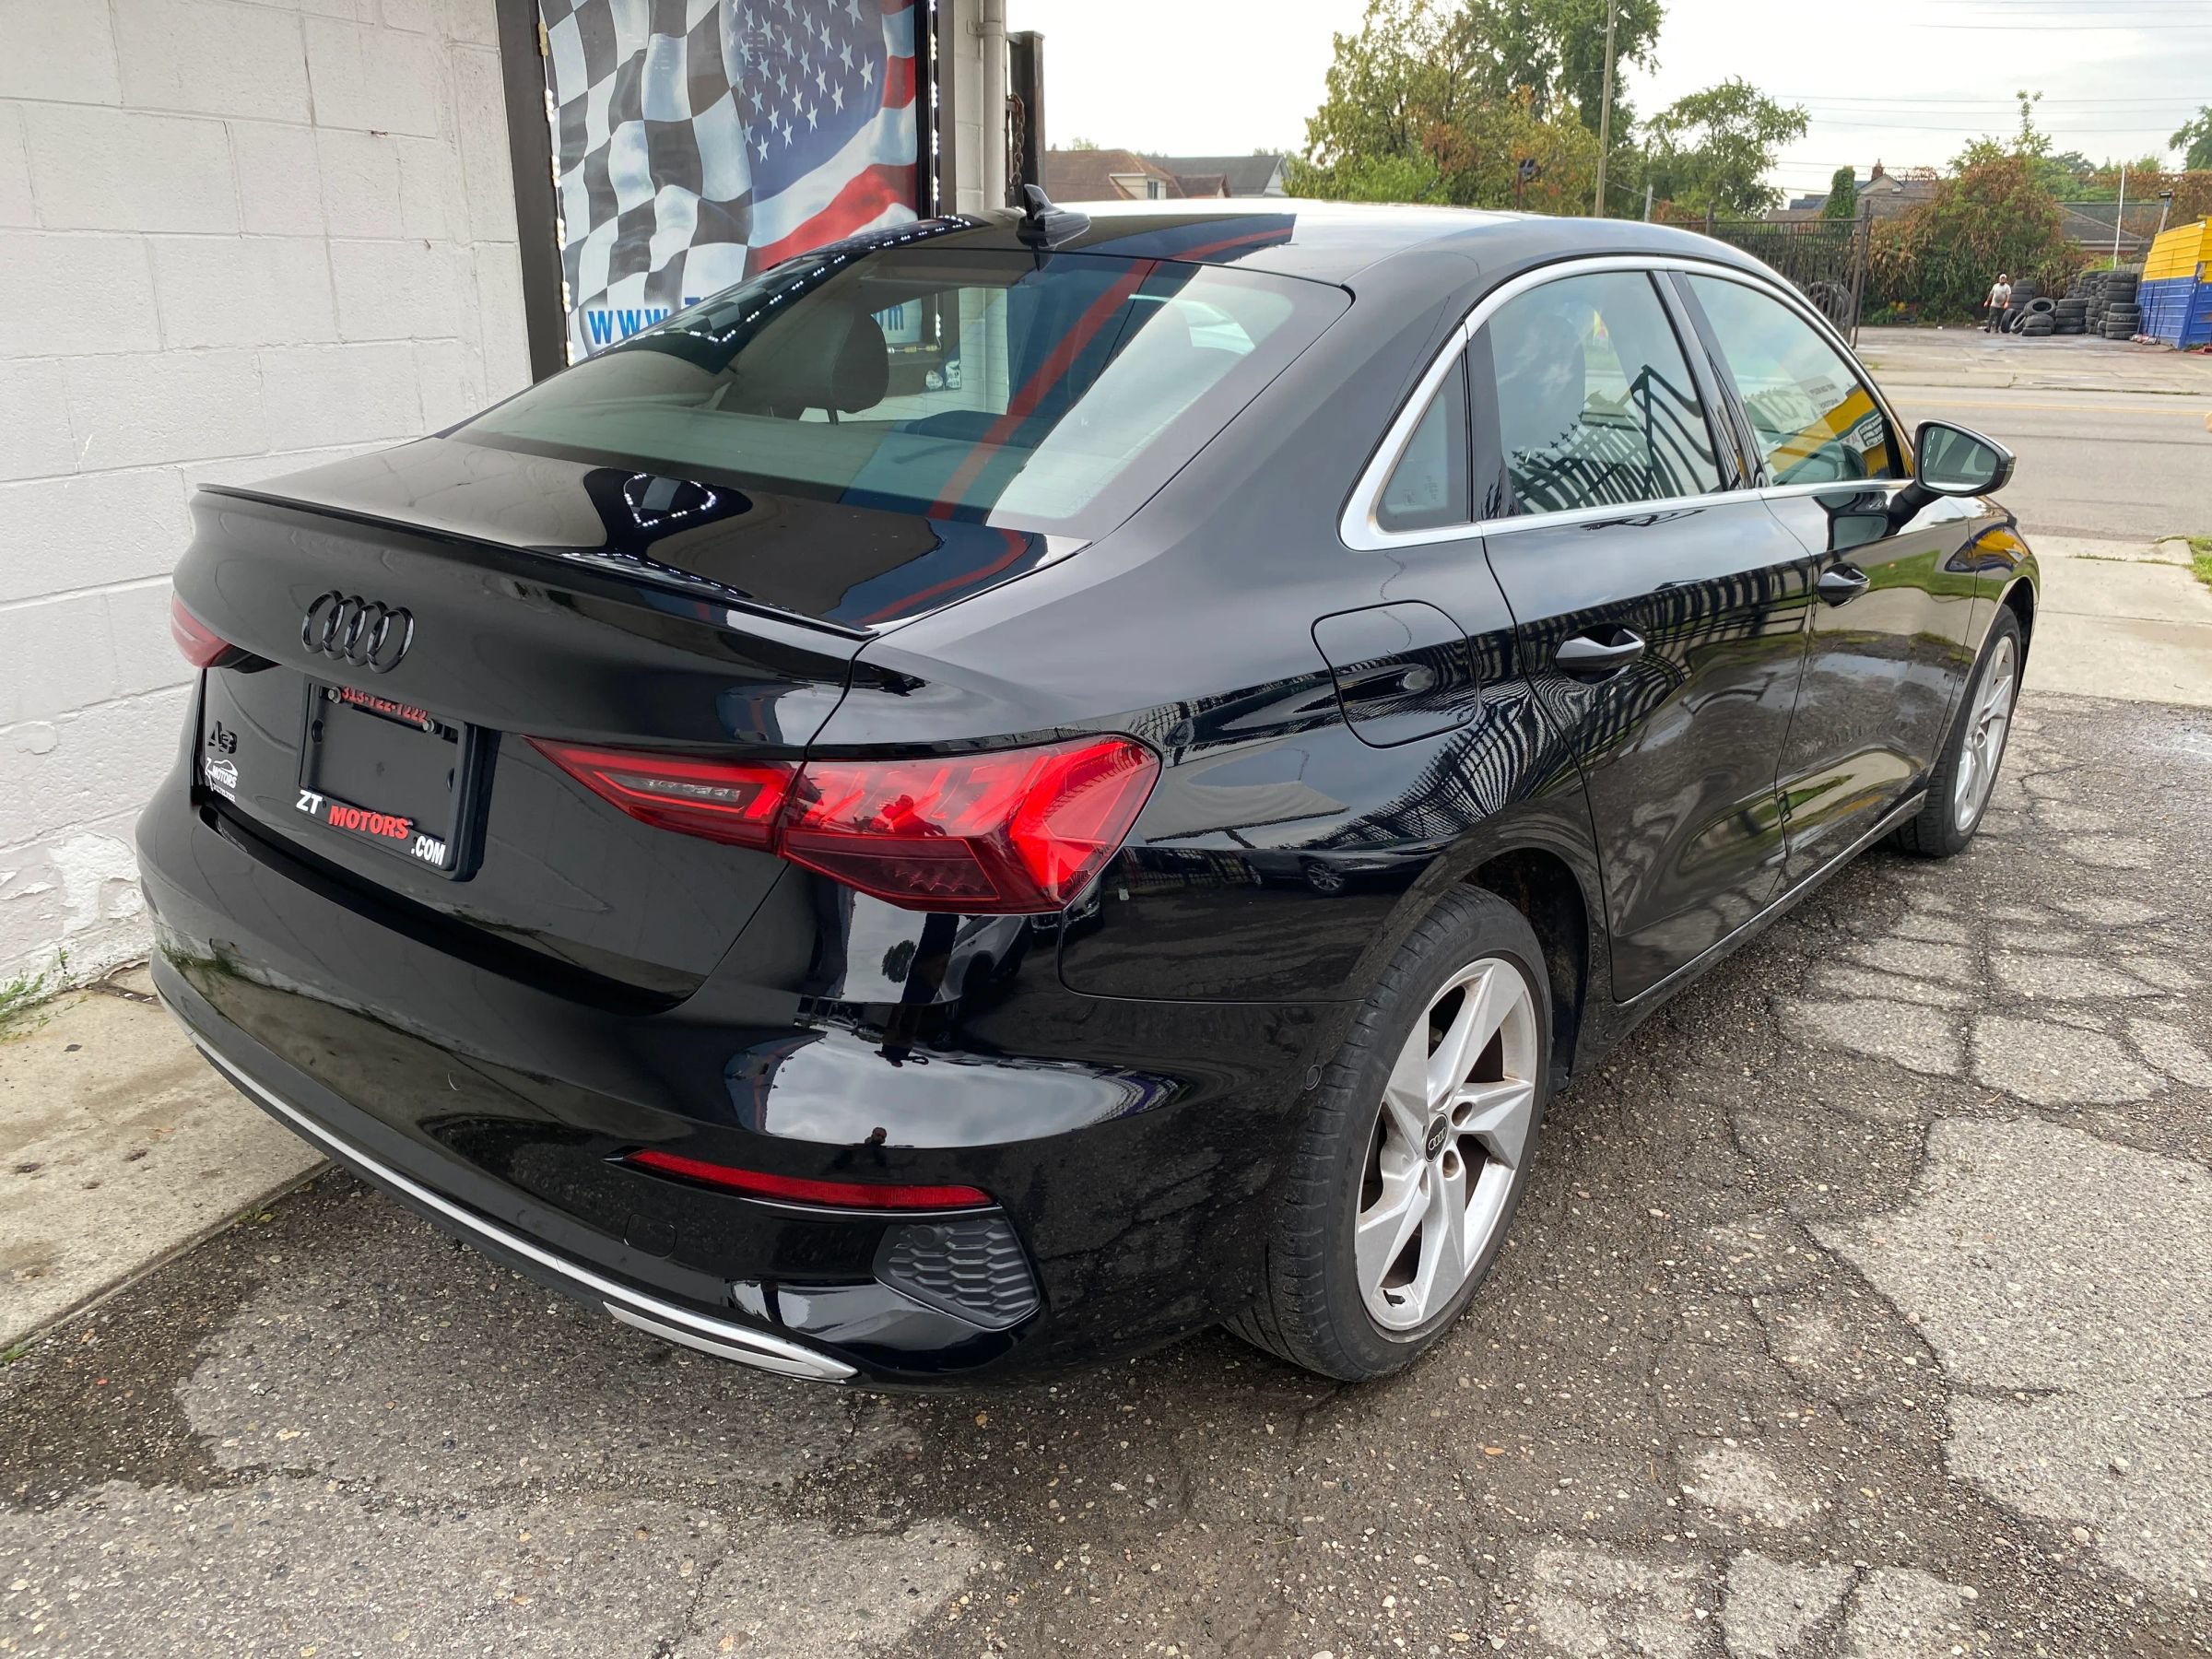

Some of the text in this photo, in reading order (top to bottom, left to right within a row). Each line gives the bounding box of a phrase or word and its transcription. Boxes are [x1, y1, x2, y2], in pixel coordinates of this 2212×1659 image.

[296, 789, 446, 866] ZT MOTORS .COM
